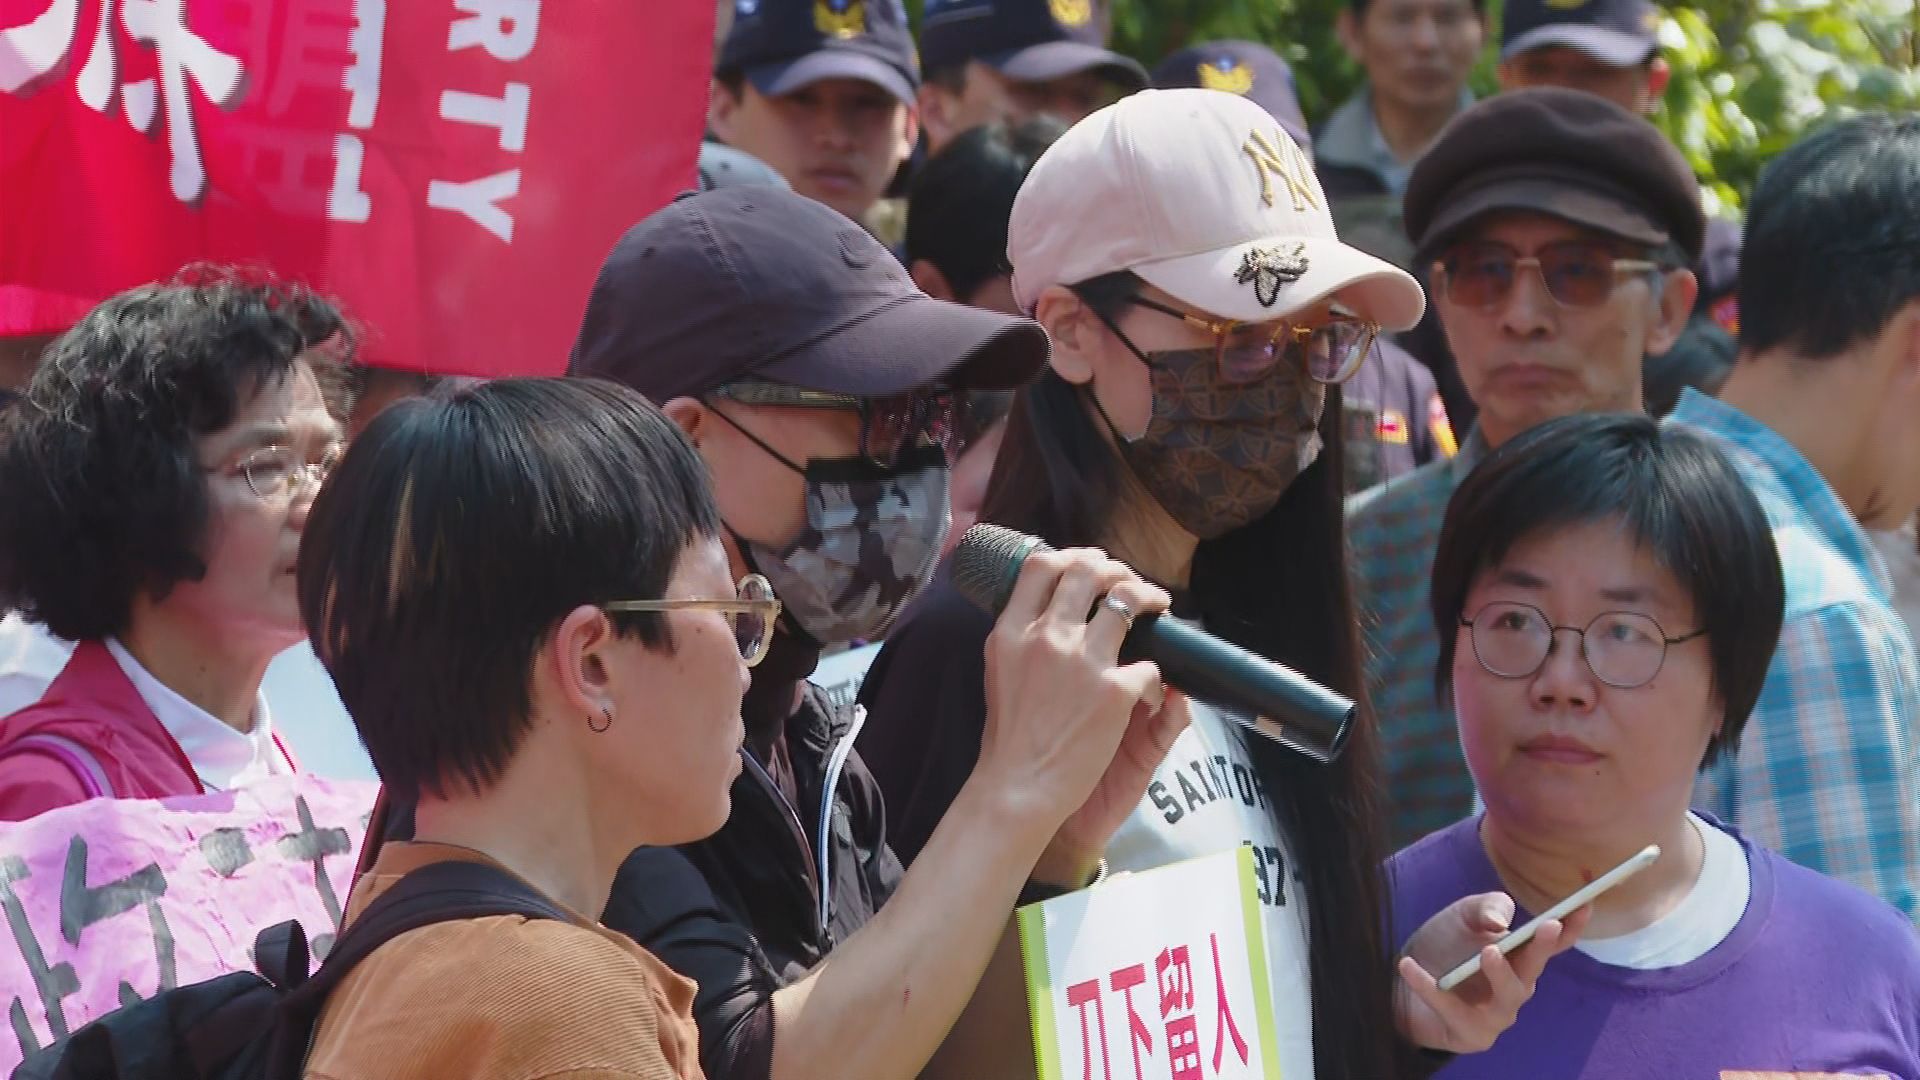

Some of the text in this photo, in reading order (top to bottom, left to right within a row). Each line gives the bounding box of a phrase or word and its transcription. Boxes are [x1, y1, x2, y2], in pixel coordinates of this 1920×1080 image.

[1242, 128, 1319, 211] NY
[1148, 755, 1265, 825] SAINTO
[1066, 932, 1249, 1080] 刀下留人
